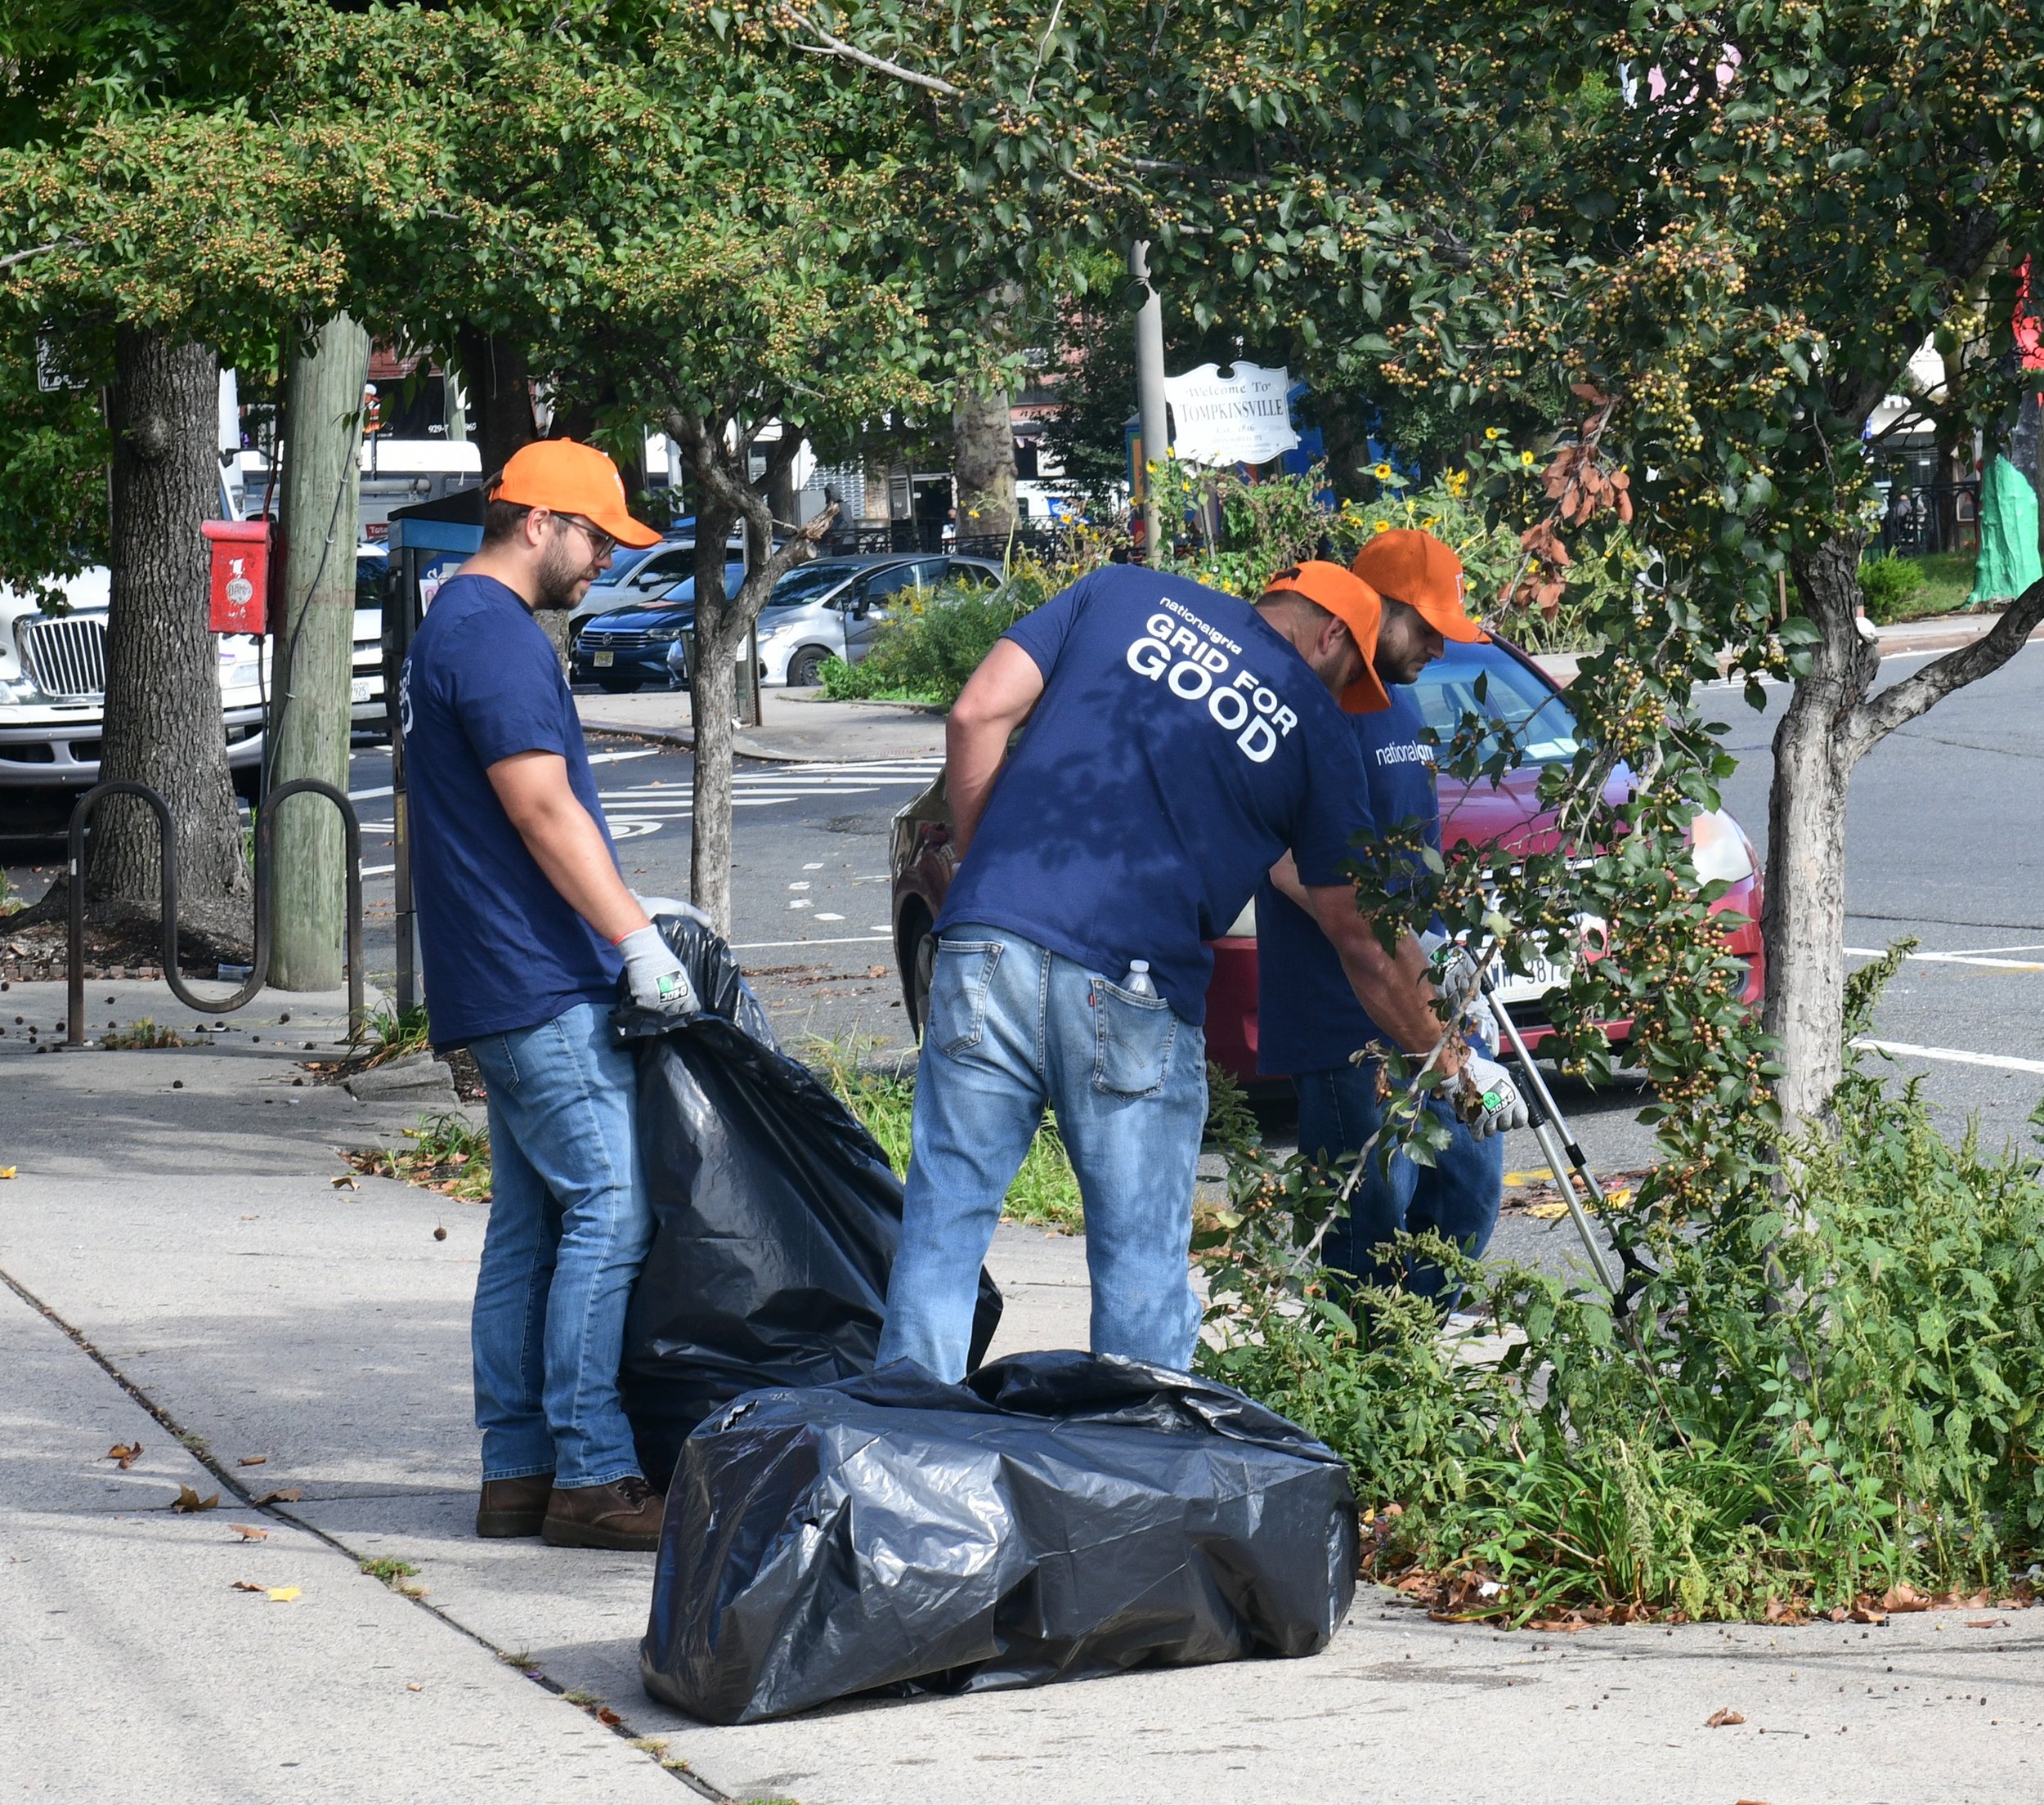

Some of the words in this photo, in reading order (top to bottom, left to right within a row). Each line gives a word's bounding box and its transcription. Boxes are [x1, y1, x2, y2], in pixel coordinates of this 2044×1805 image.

[1179, 398, 1284, 423] TOMPKINSVILLE
[1189, 384, 1246, 398] Welcome
[1252, 382, 1268, 393] To
[1127, 637, 1277, 763] GOOD
[1146, 613, 1230, 674] GRID
[1232, 670, 1298, 738] FOR
